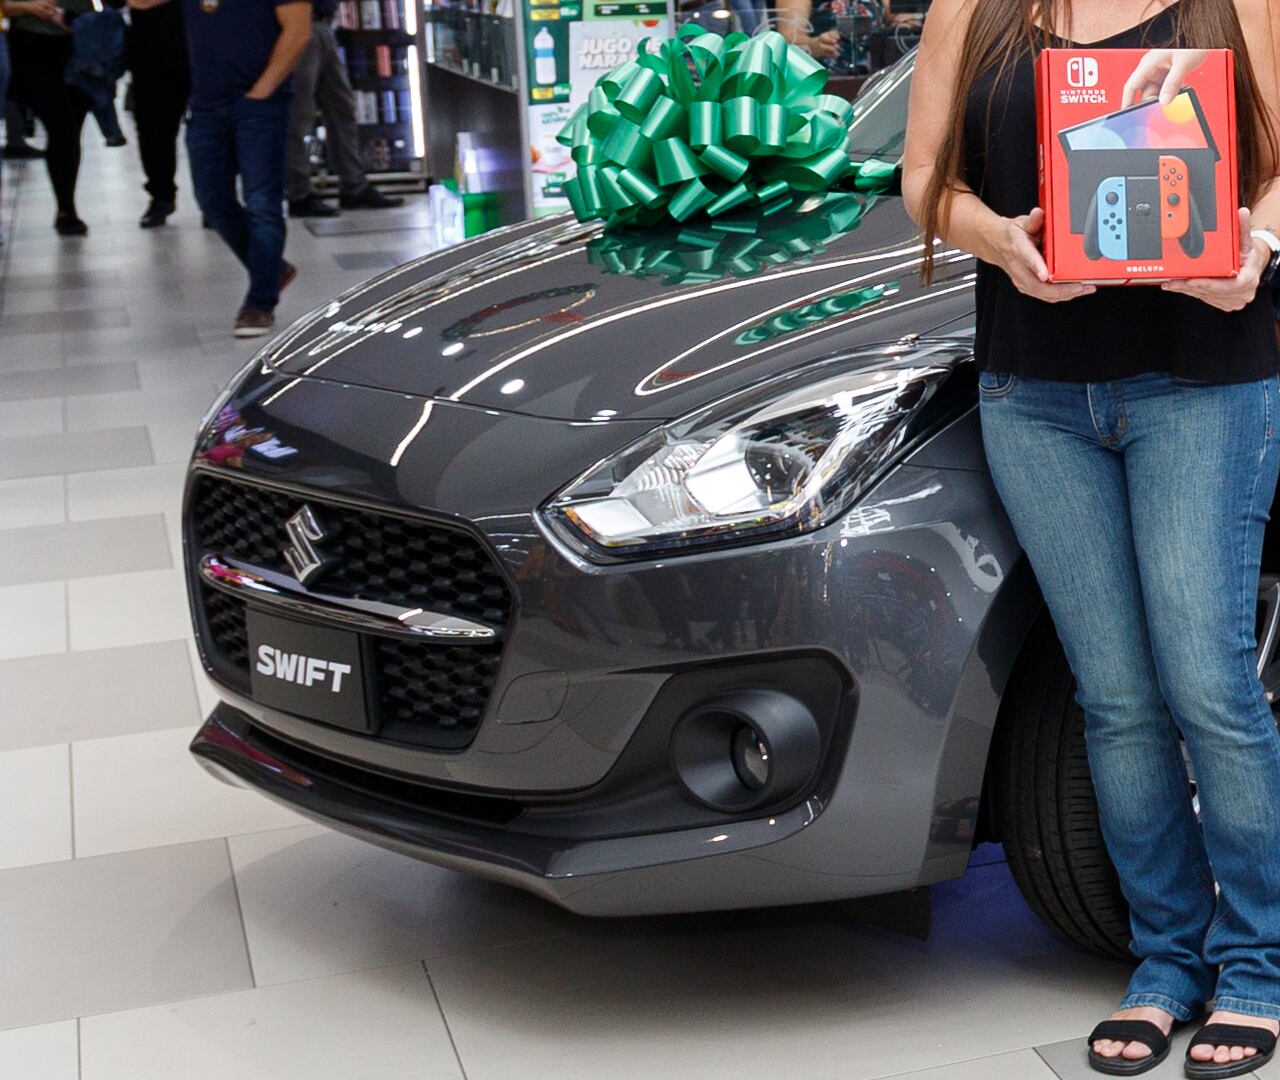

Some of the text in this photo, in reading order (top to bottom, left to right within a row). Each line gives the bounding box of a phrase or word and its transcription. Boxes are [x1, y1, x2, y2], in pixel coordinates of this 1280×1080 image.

[578, 38, 632, 55] JUGO
[579, 54, 638, 70] NARA
[1060, 94, 1106, 104] SWITCH
[256, 644, 352, 692] SWIFT
